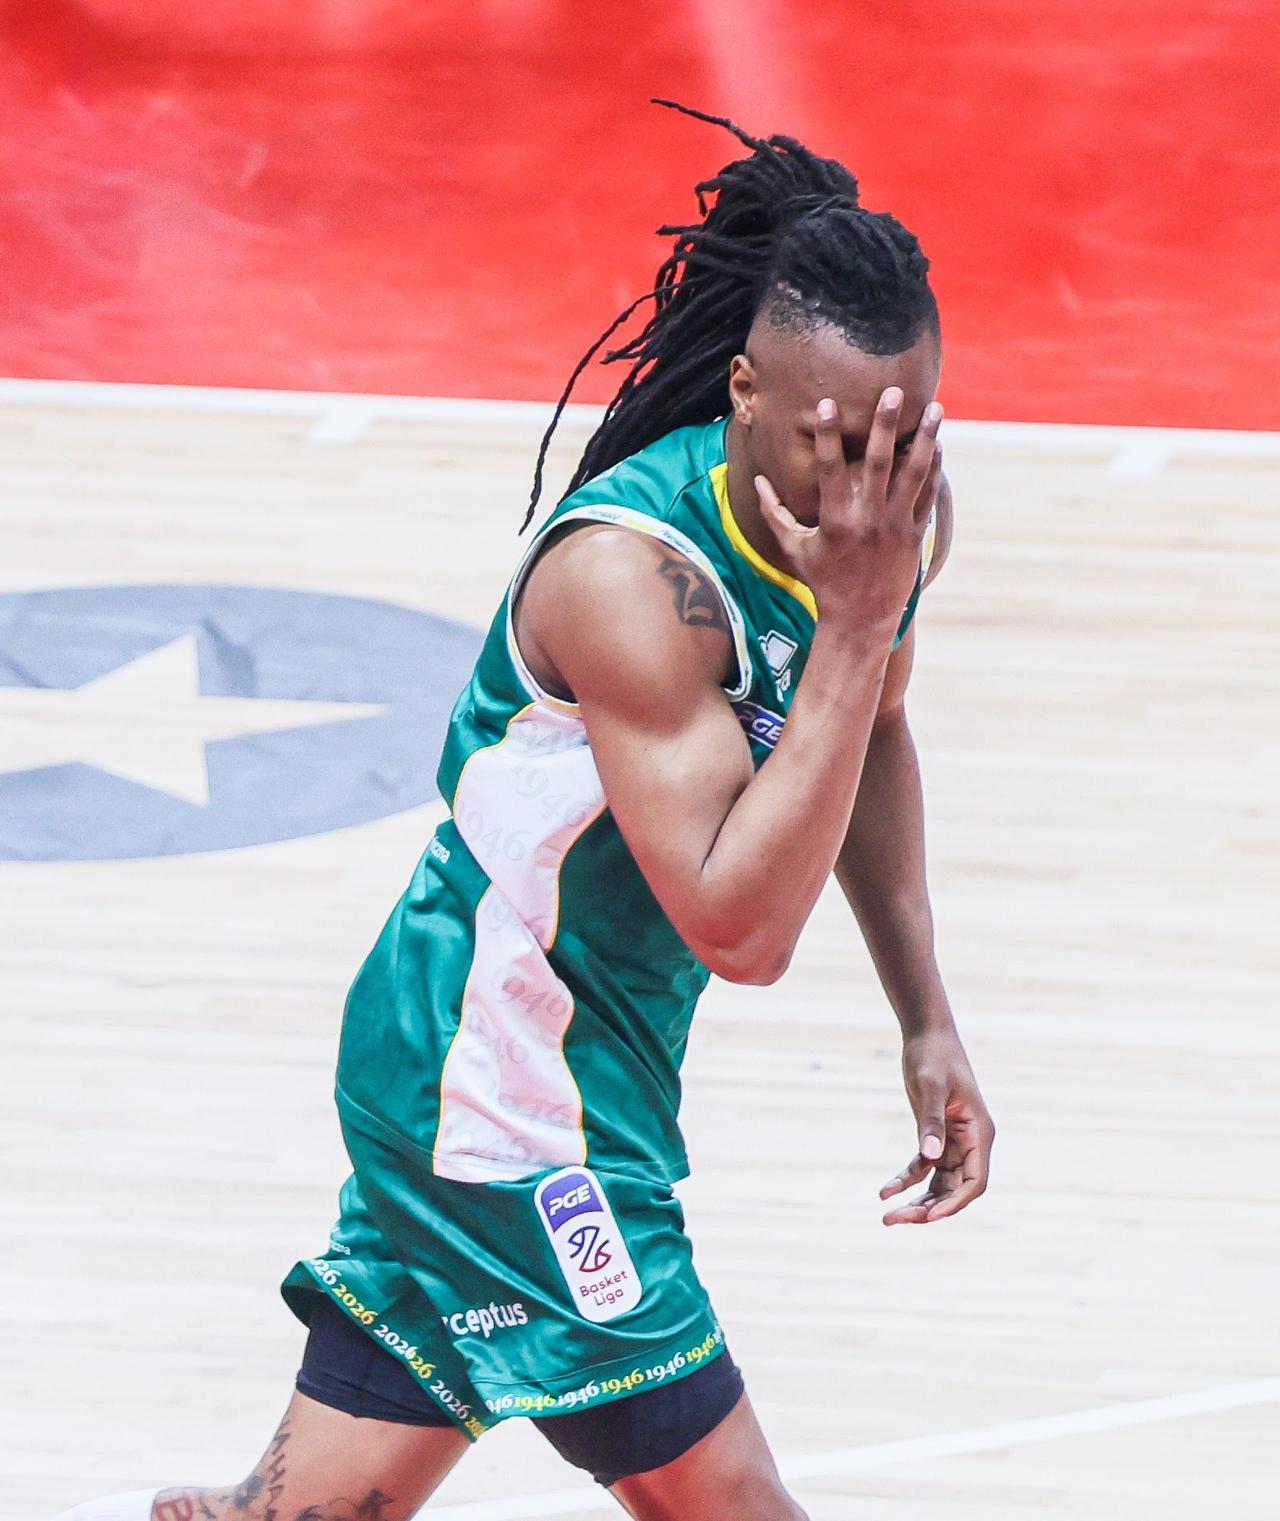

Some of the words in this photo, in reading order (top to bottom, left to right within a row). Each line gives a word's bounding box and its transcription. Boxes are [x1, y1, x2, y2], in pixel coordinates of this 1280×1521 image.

[549, 1183, 592, 1217] PGE
[579, 1270, 628, 1297] Basket
[593, 1287, 625, 1307] Liga
[441, 1301, 529, 1339] ceptus
[332, 1283, 379, 1325] 2026
[373, 1324, 418, 1360] 2026
[429, 1379, 473, 1420] 2026
[556, 1380, 600, 1408] 1946
[599, 1368, 645, 1395] 1946
[645, 1352, 686, 1382] 1946
[684, 1332, 715, 1364] 1946
